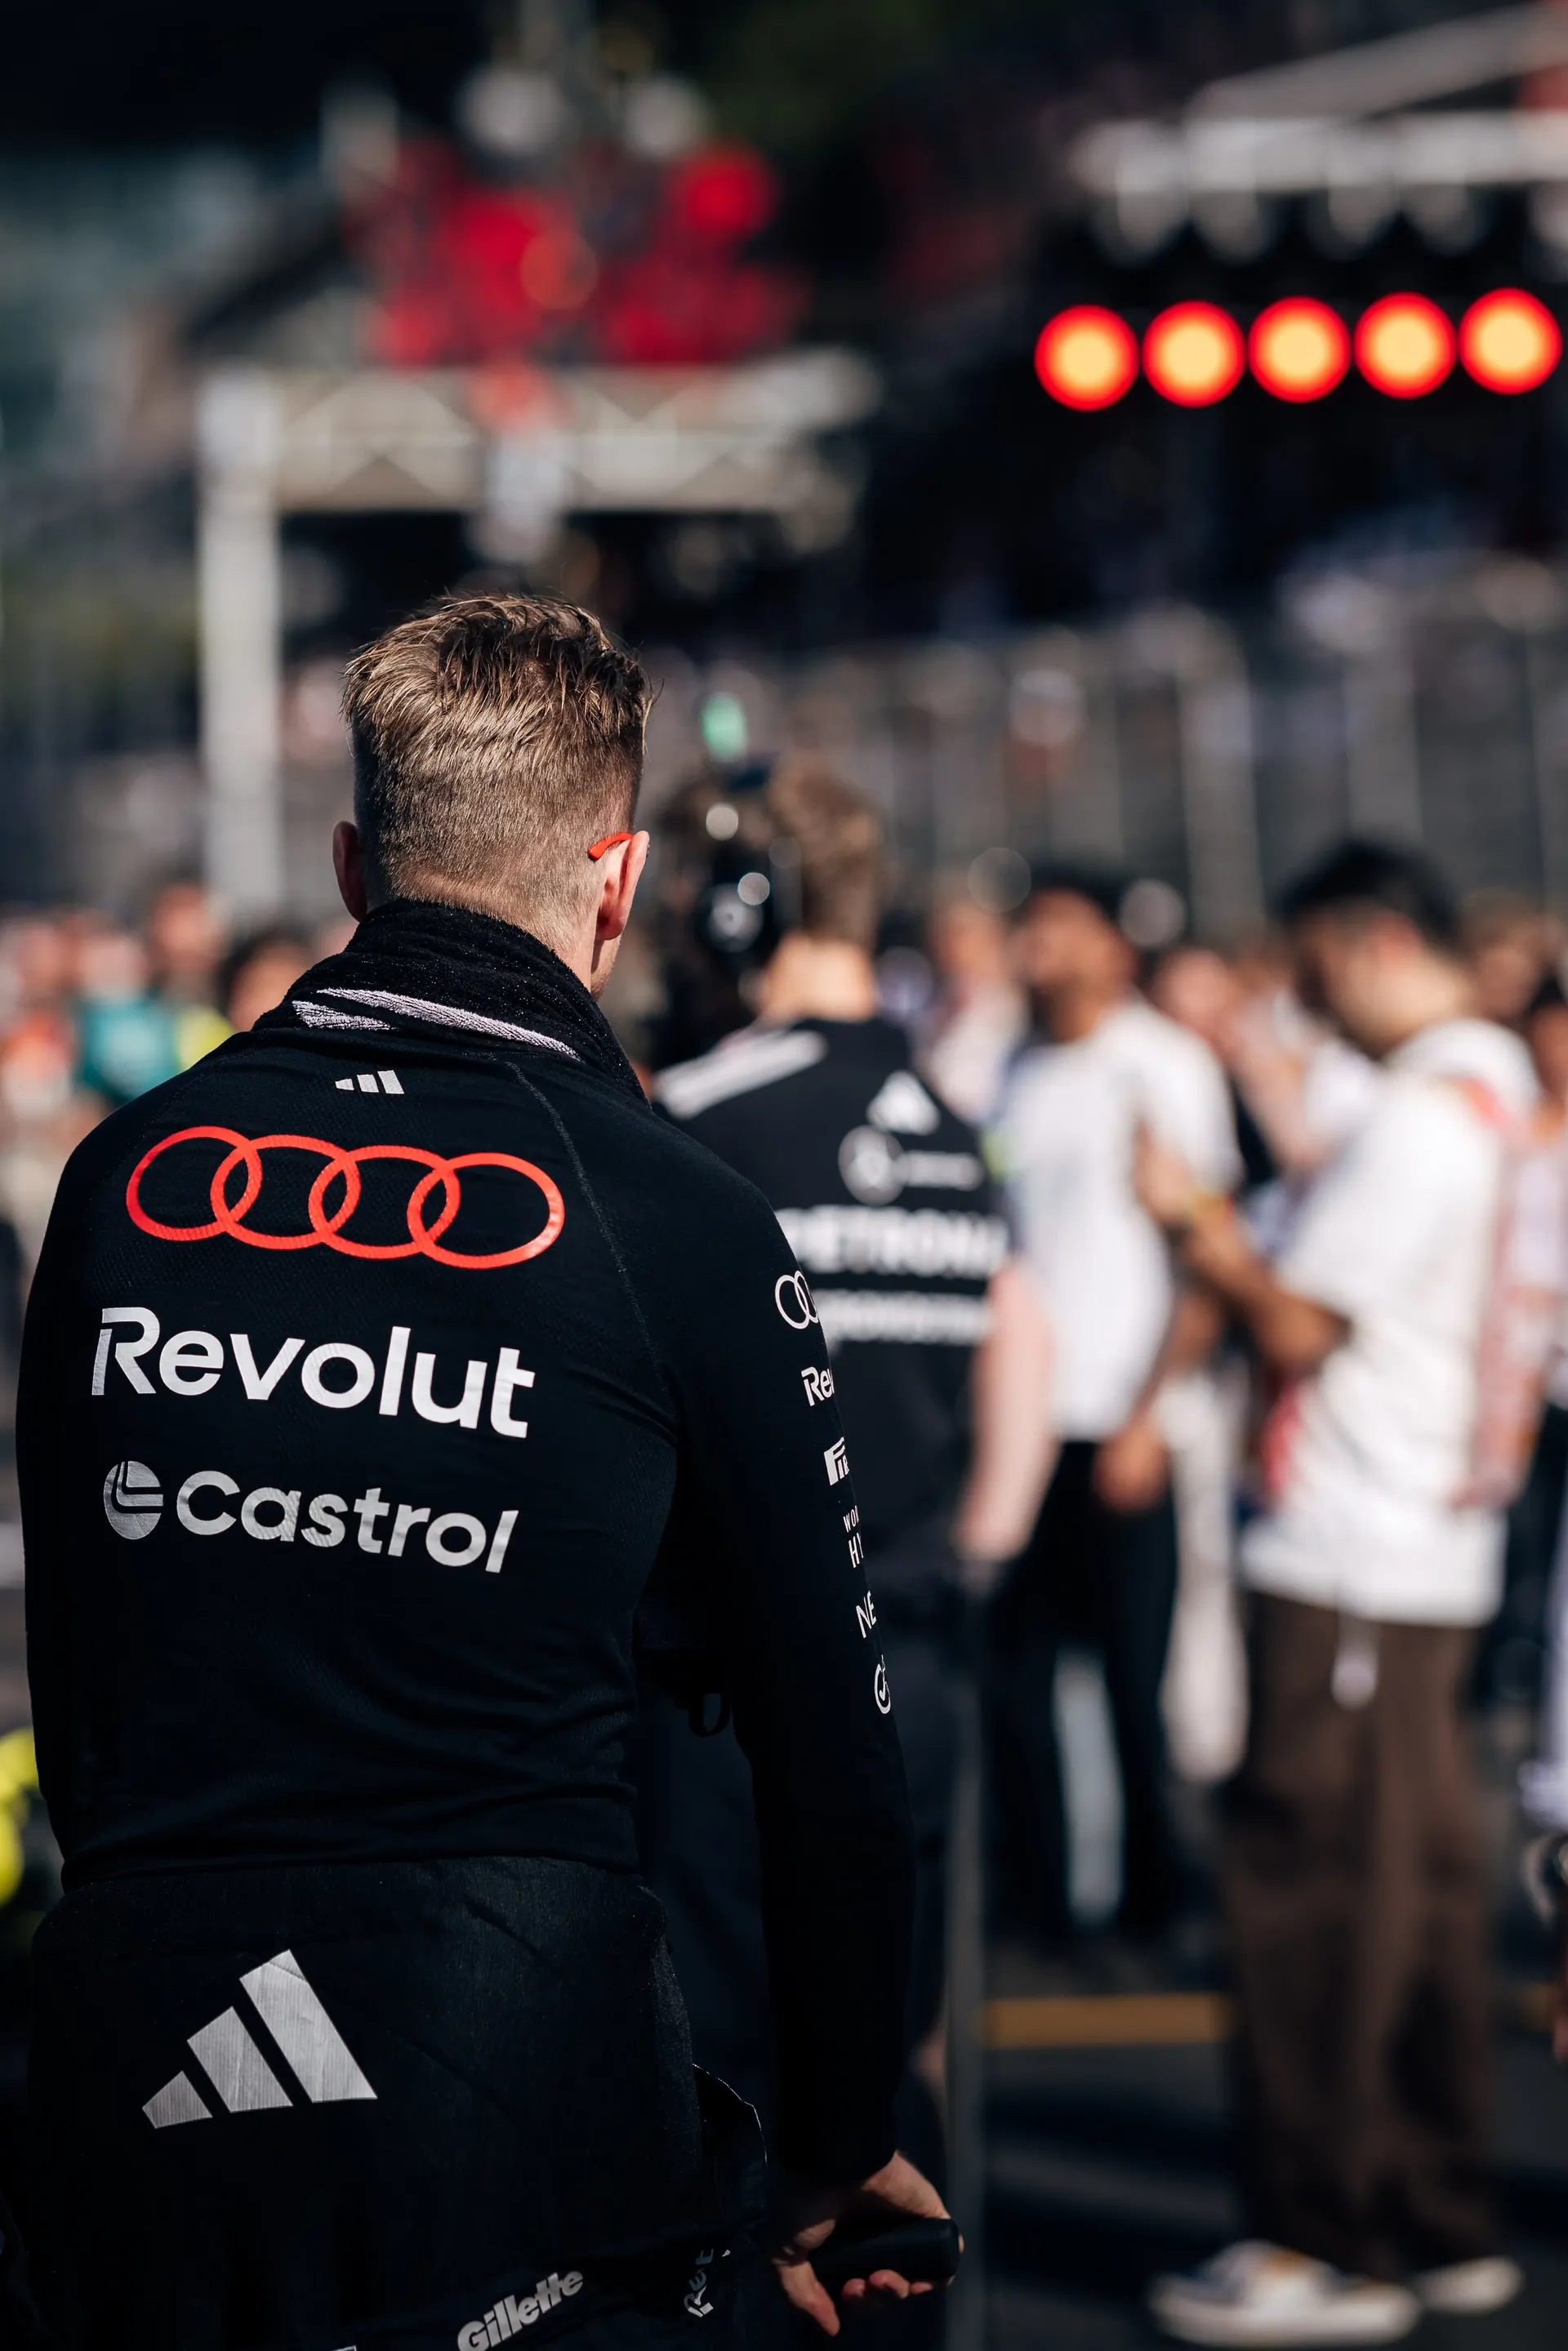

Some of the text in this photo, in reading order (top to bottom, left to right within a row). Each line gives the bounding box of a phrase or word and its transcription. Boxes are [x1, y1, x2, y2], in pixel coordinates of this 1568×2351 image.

[91, 1307, 536, 1438] Revolut
[176, 1471, 519, 1574] Castrol
[457, 2270, 584, 2351] Gillette
